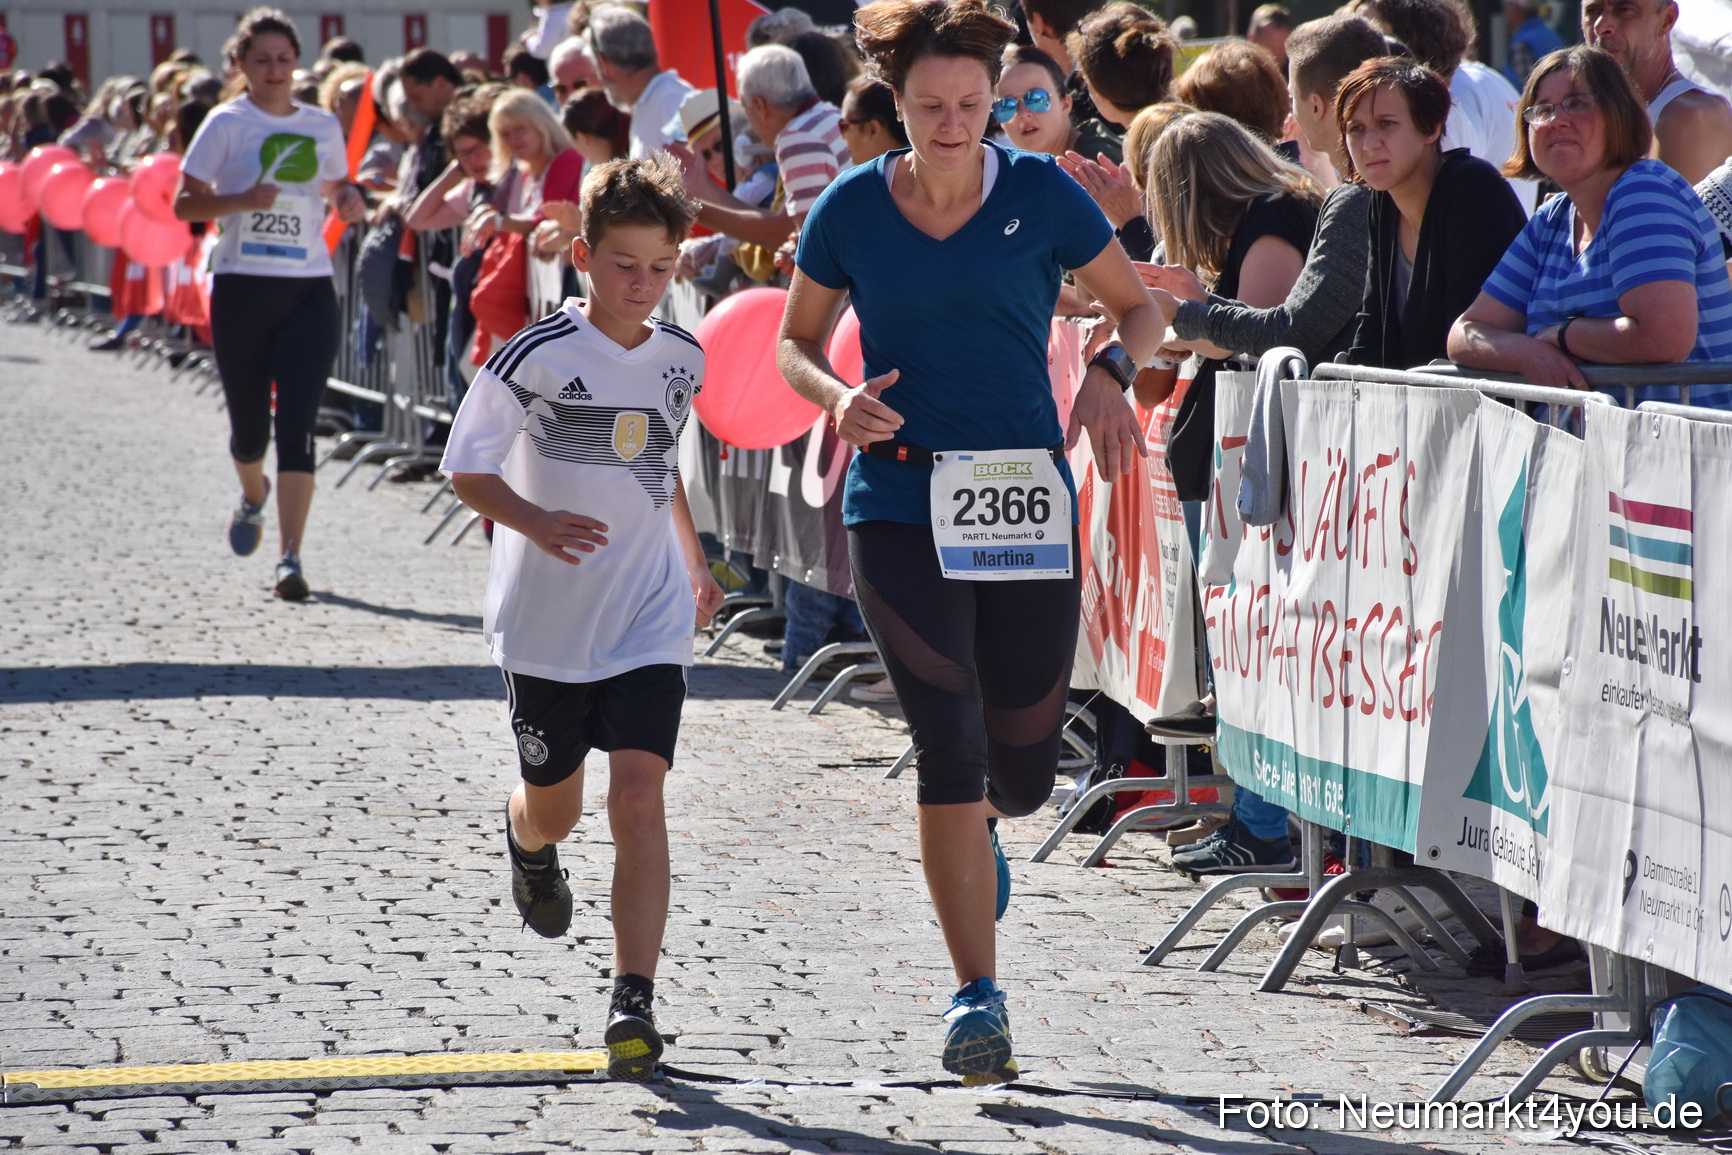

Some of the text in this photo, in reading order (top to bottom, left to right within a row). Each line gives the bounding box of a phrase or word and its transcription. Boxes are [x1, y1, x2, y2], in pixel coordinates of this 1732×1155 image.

[251, 212, 301, 236] 2253
[558, 390, 593, 401] adidas
[973, 462, 1034, 477] BOCK
[952, 486, 1051, 526] 2366
[962, 532, 1032, 541] PARTL Neumarkt
[972, 550, 1035, 567] Martina
[1457, 816, 1490, 853] Jura
[1643, 855, 1692, 893] Dammstraße
[1640, 889, 1680, 925] Neumarkt
